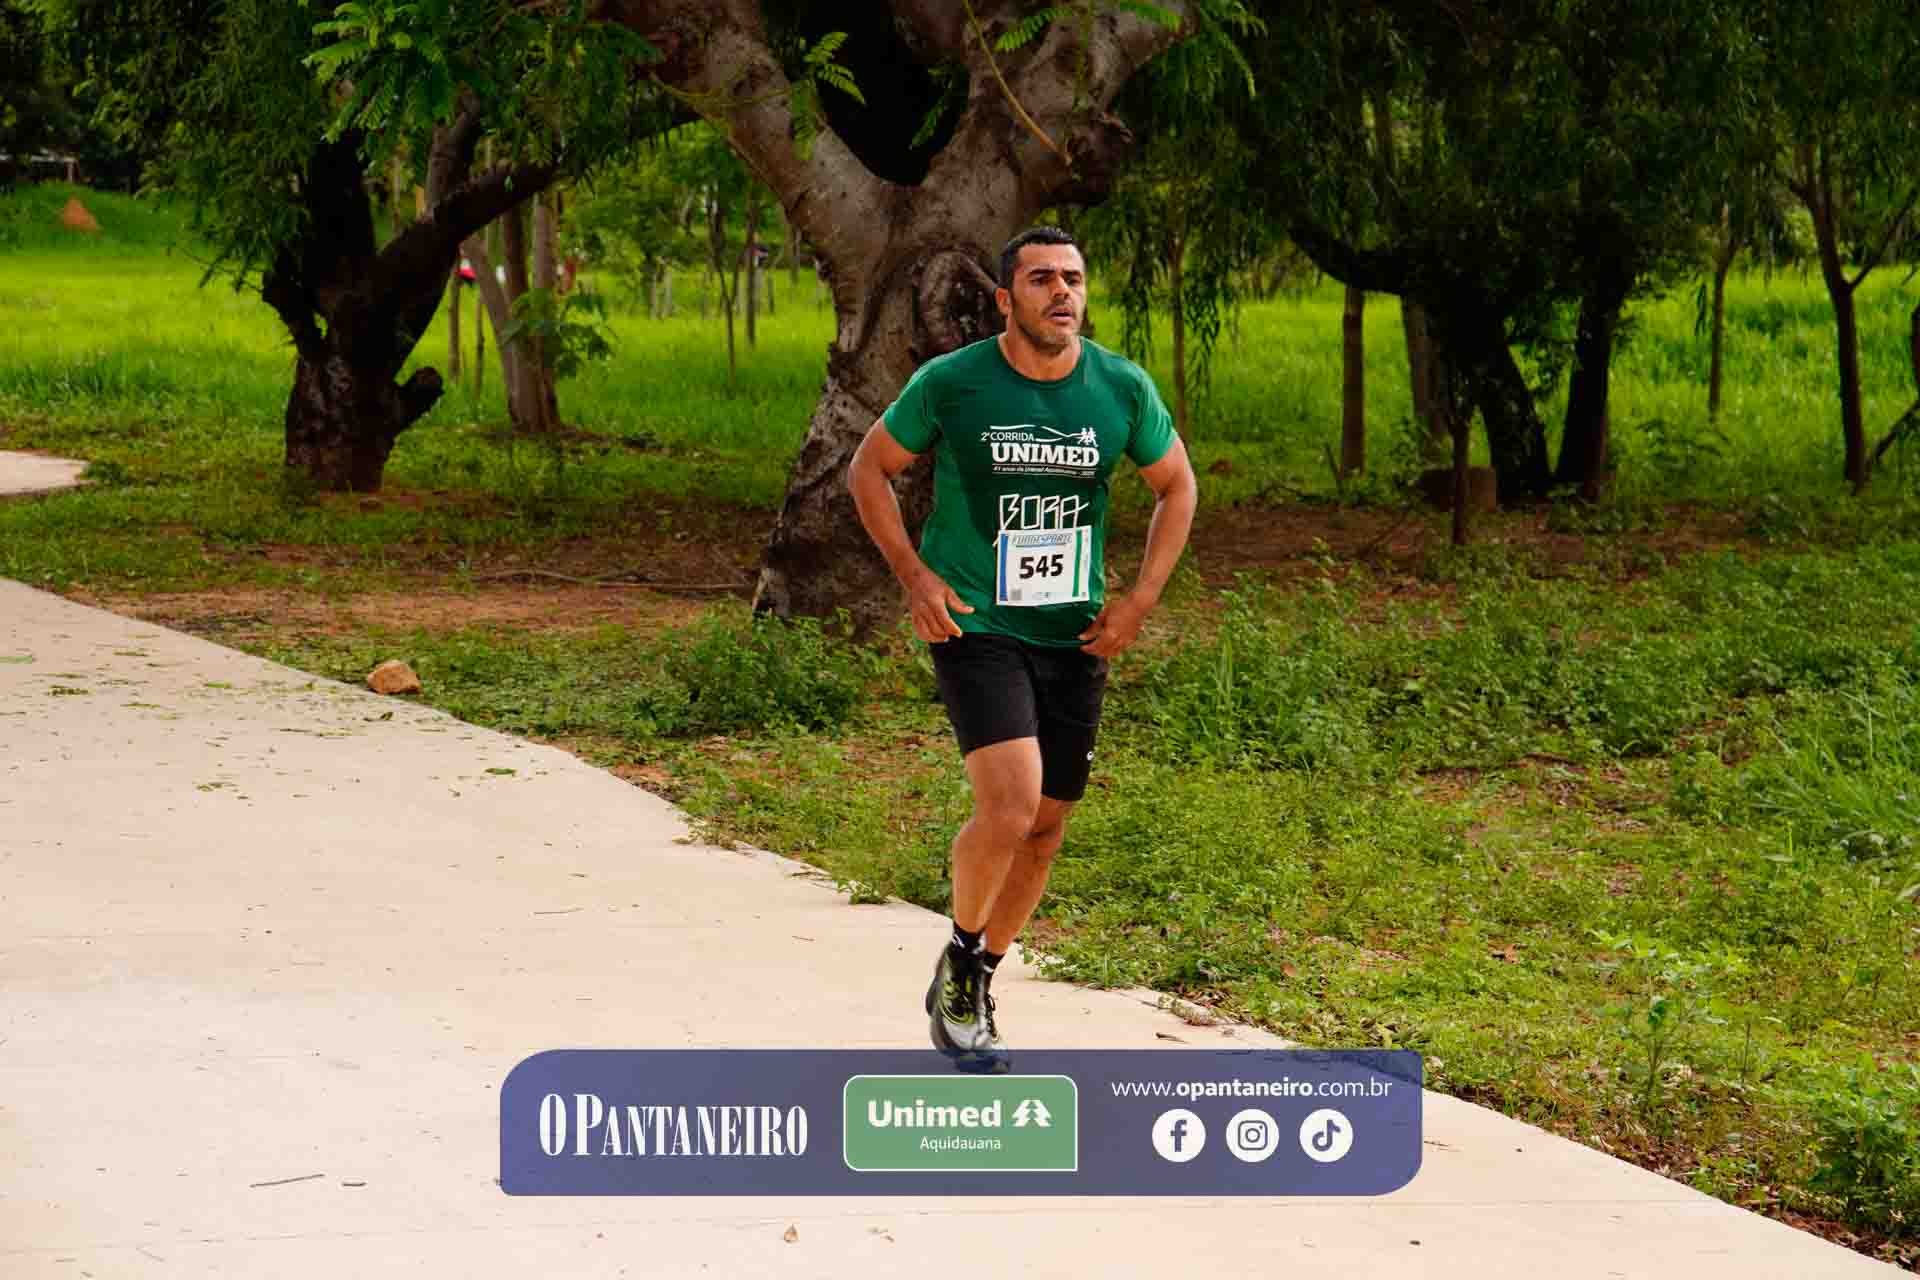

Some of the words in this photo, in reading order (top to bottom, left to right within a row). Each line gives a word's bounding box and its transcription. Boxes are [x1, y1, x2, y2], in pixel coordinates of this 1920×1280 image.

[990, 432, 1035, 441] CORRIDA
[990, 442, 1100, 467] UNIMED
[998, 493, 1090, 532] BORA
[1019, 554, 1064, 579] 545
